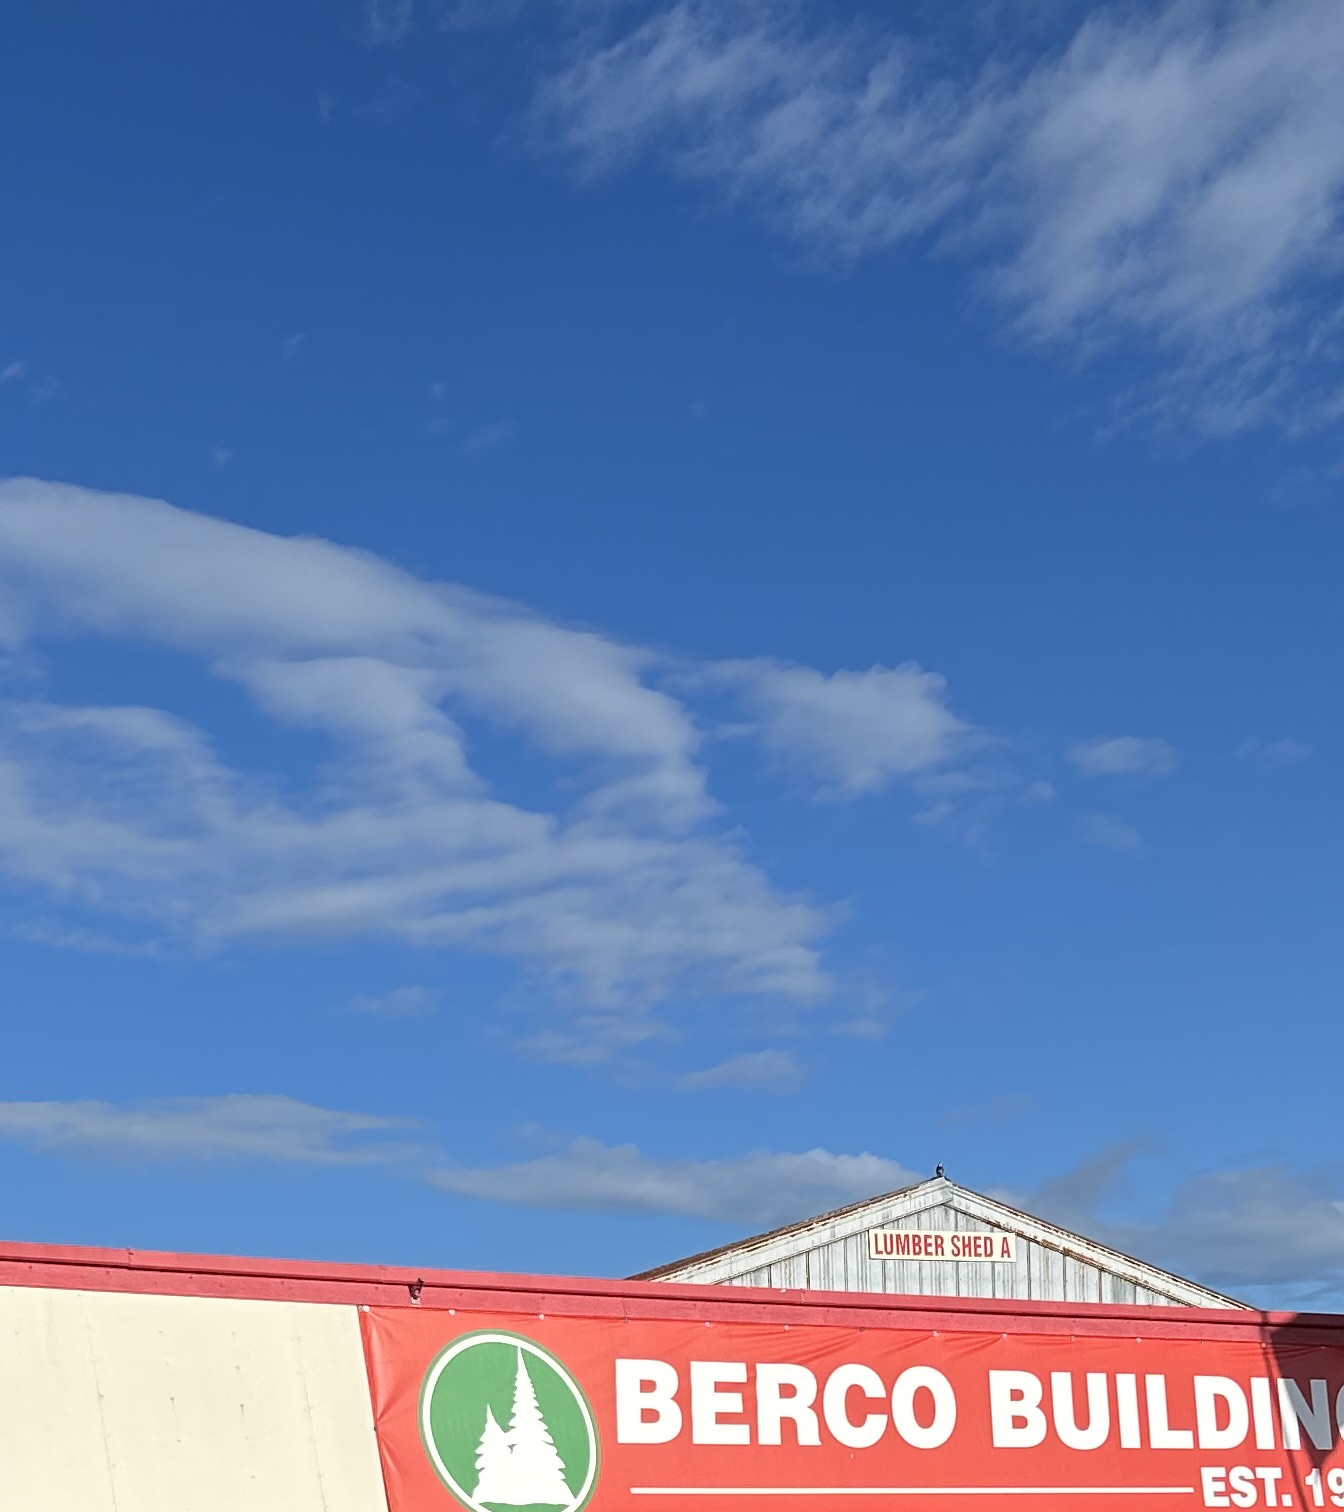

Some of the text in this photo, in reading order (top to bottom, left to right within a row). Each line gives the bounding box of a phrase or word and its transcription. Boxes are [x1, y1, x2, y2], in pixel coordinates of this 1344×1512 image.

[874, 1233, 1011, 1258] LUMBER SHED A
[614, 1358, 957, 1450] BERCO
[1200, 1465, 1293, 1508] EST.
